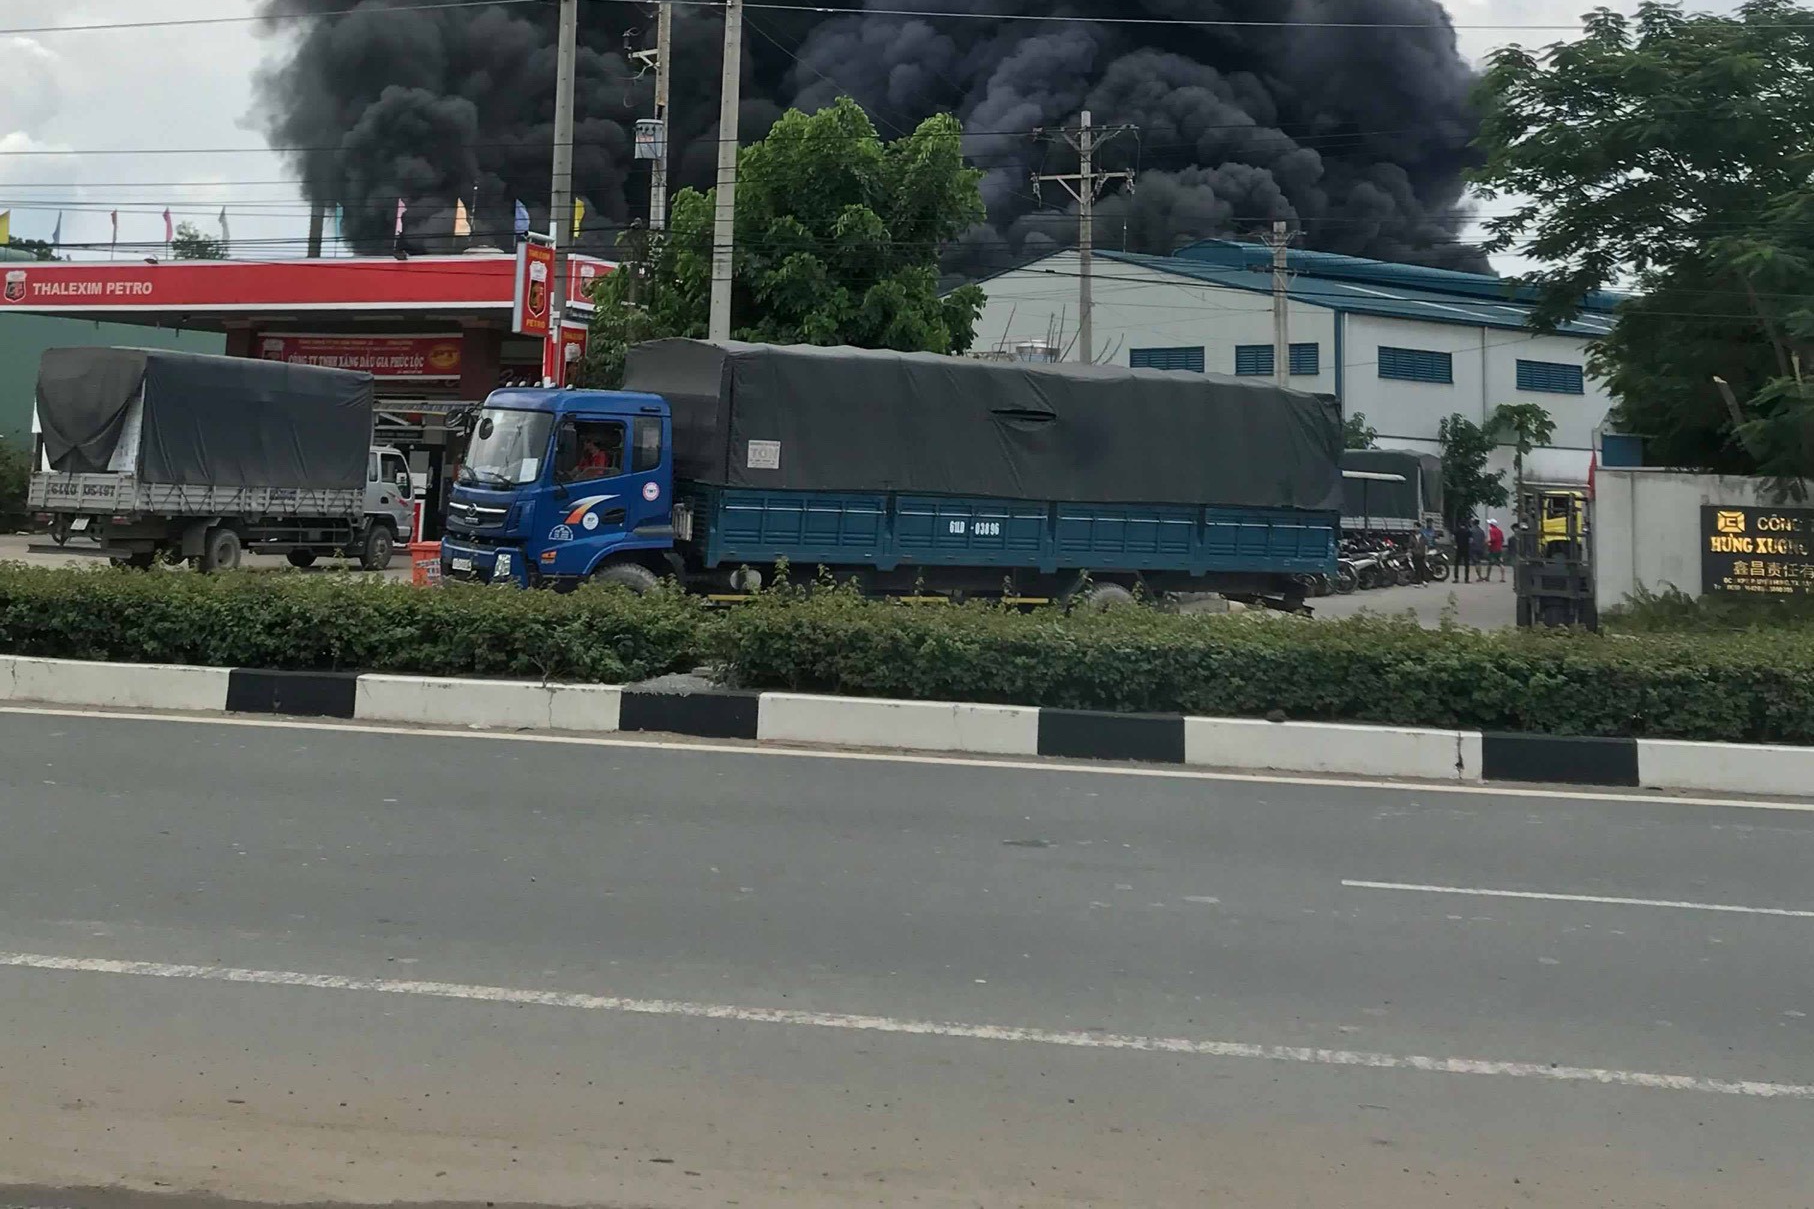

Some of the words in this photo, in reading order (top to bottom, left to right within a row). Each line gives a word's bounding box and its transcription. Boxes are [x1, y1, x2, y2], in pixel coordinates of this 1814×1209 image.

[32, 282, 102, 295] THALEXIM
[106, 282, 153, 295] PETRO
[525, 319, 546, 329] PETRO
